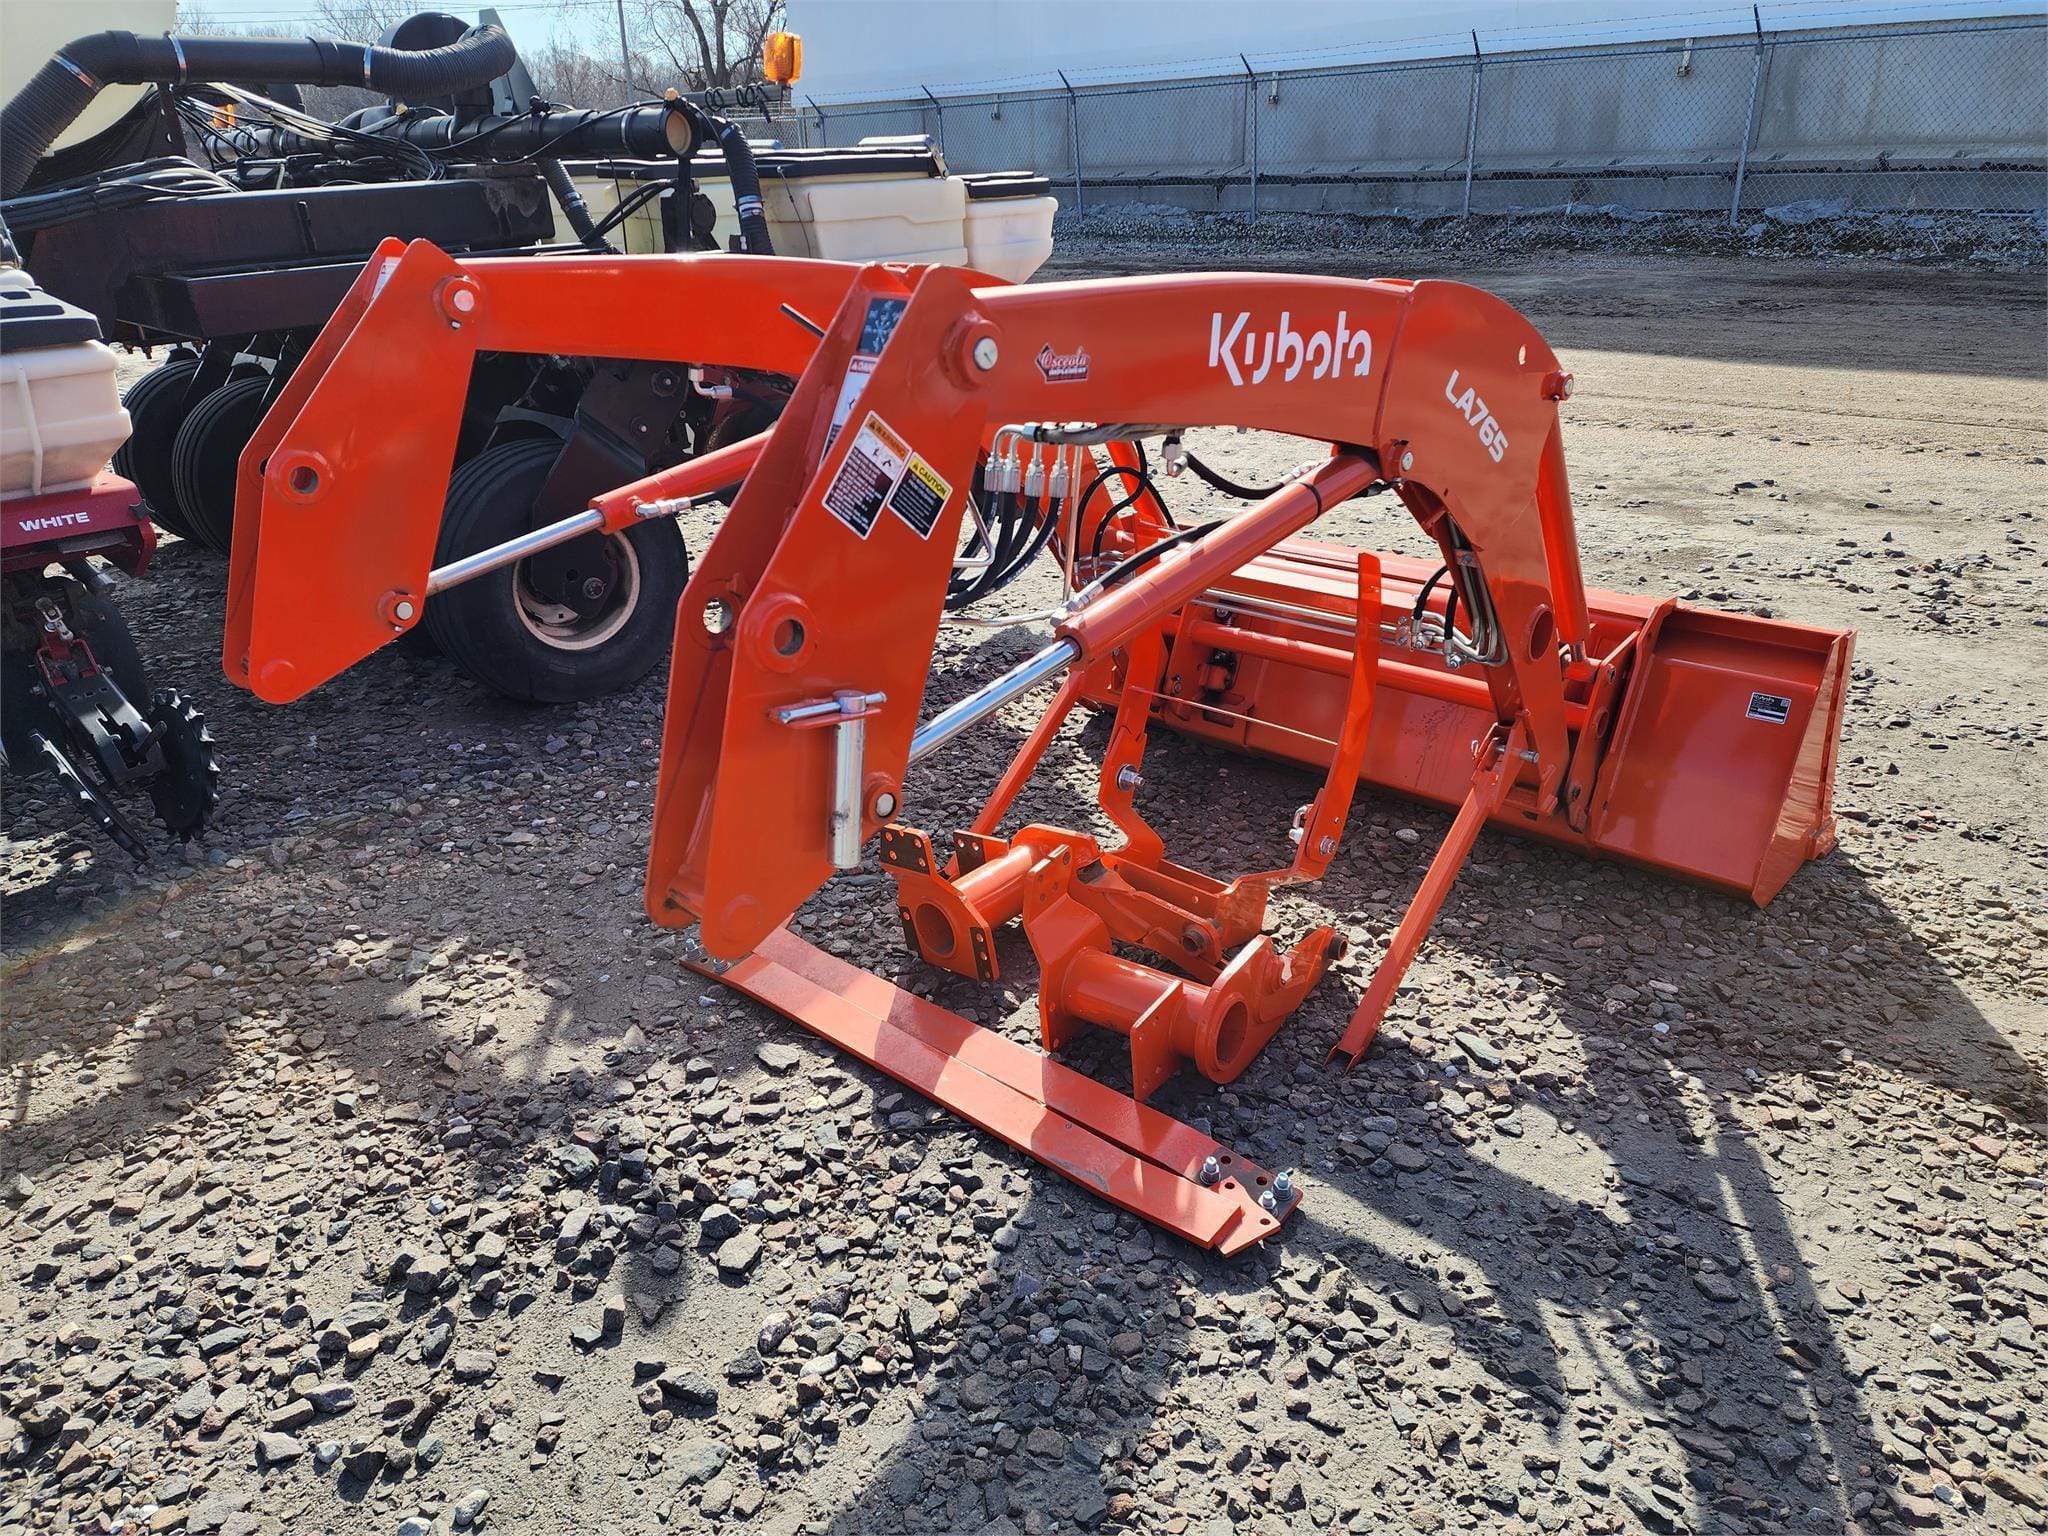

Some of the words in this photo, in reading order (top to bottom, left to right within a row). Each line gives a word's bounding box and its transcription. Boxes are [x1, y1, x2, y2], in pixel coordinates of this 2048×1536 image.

[1040, 347, 1088, 369] Osceola
[1208, 311, 1372, 386] Kubota
[1446, 369, 1509, 462] LA765
[918, 466, 947, 496] CAUTION
[19, 511, 90, 531] WHITE
